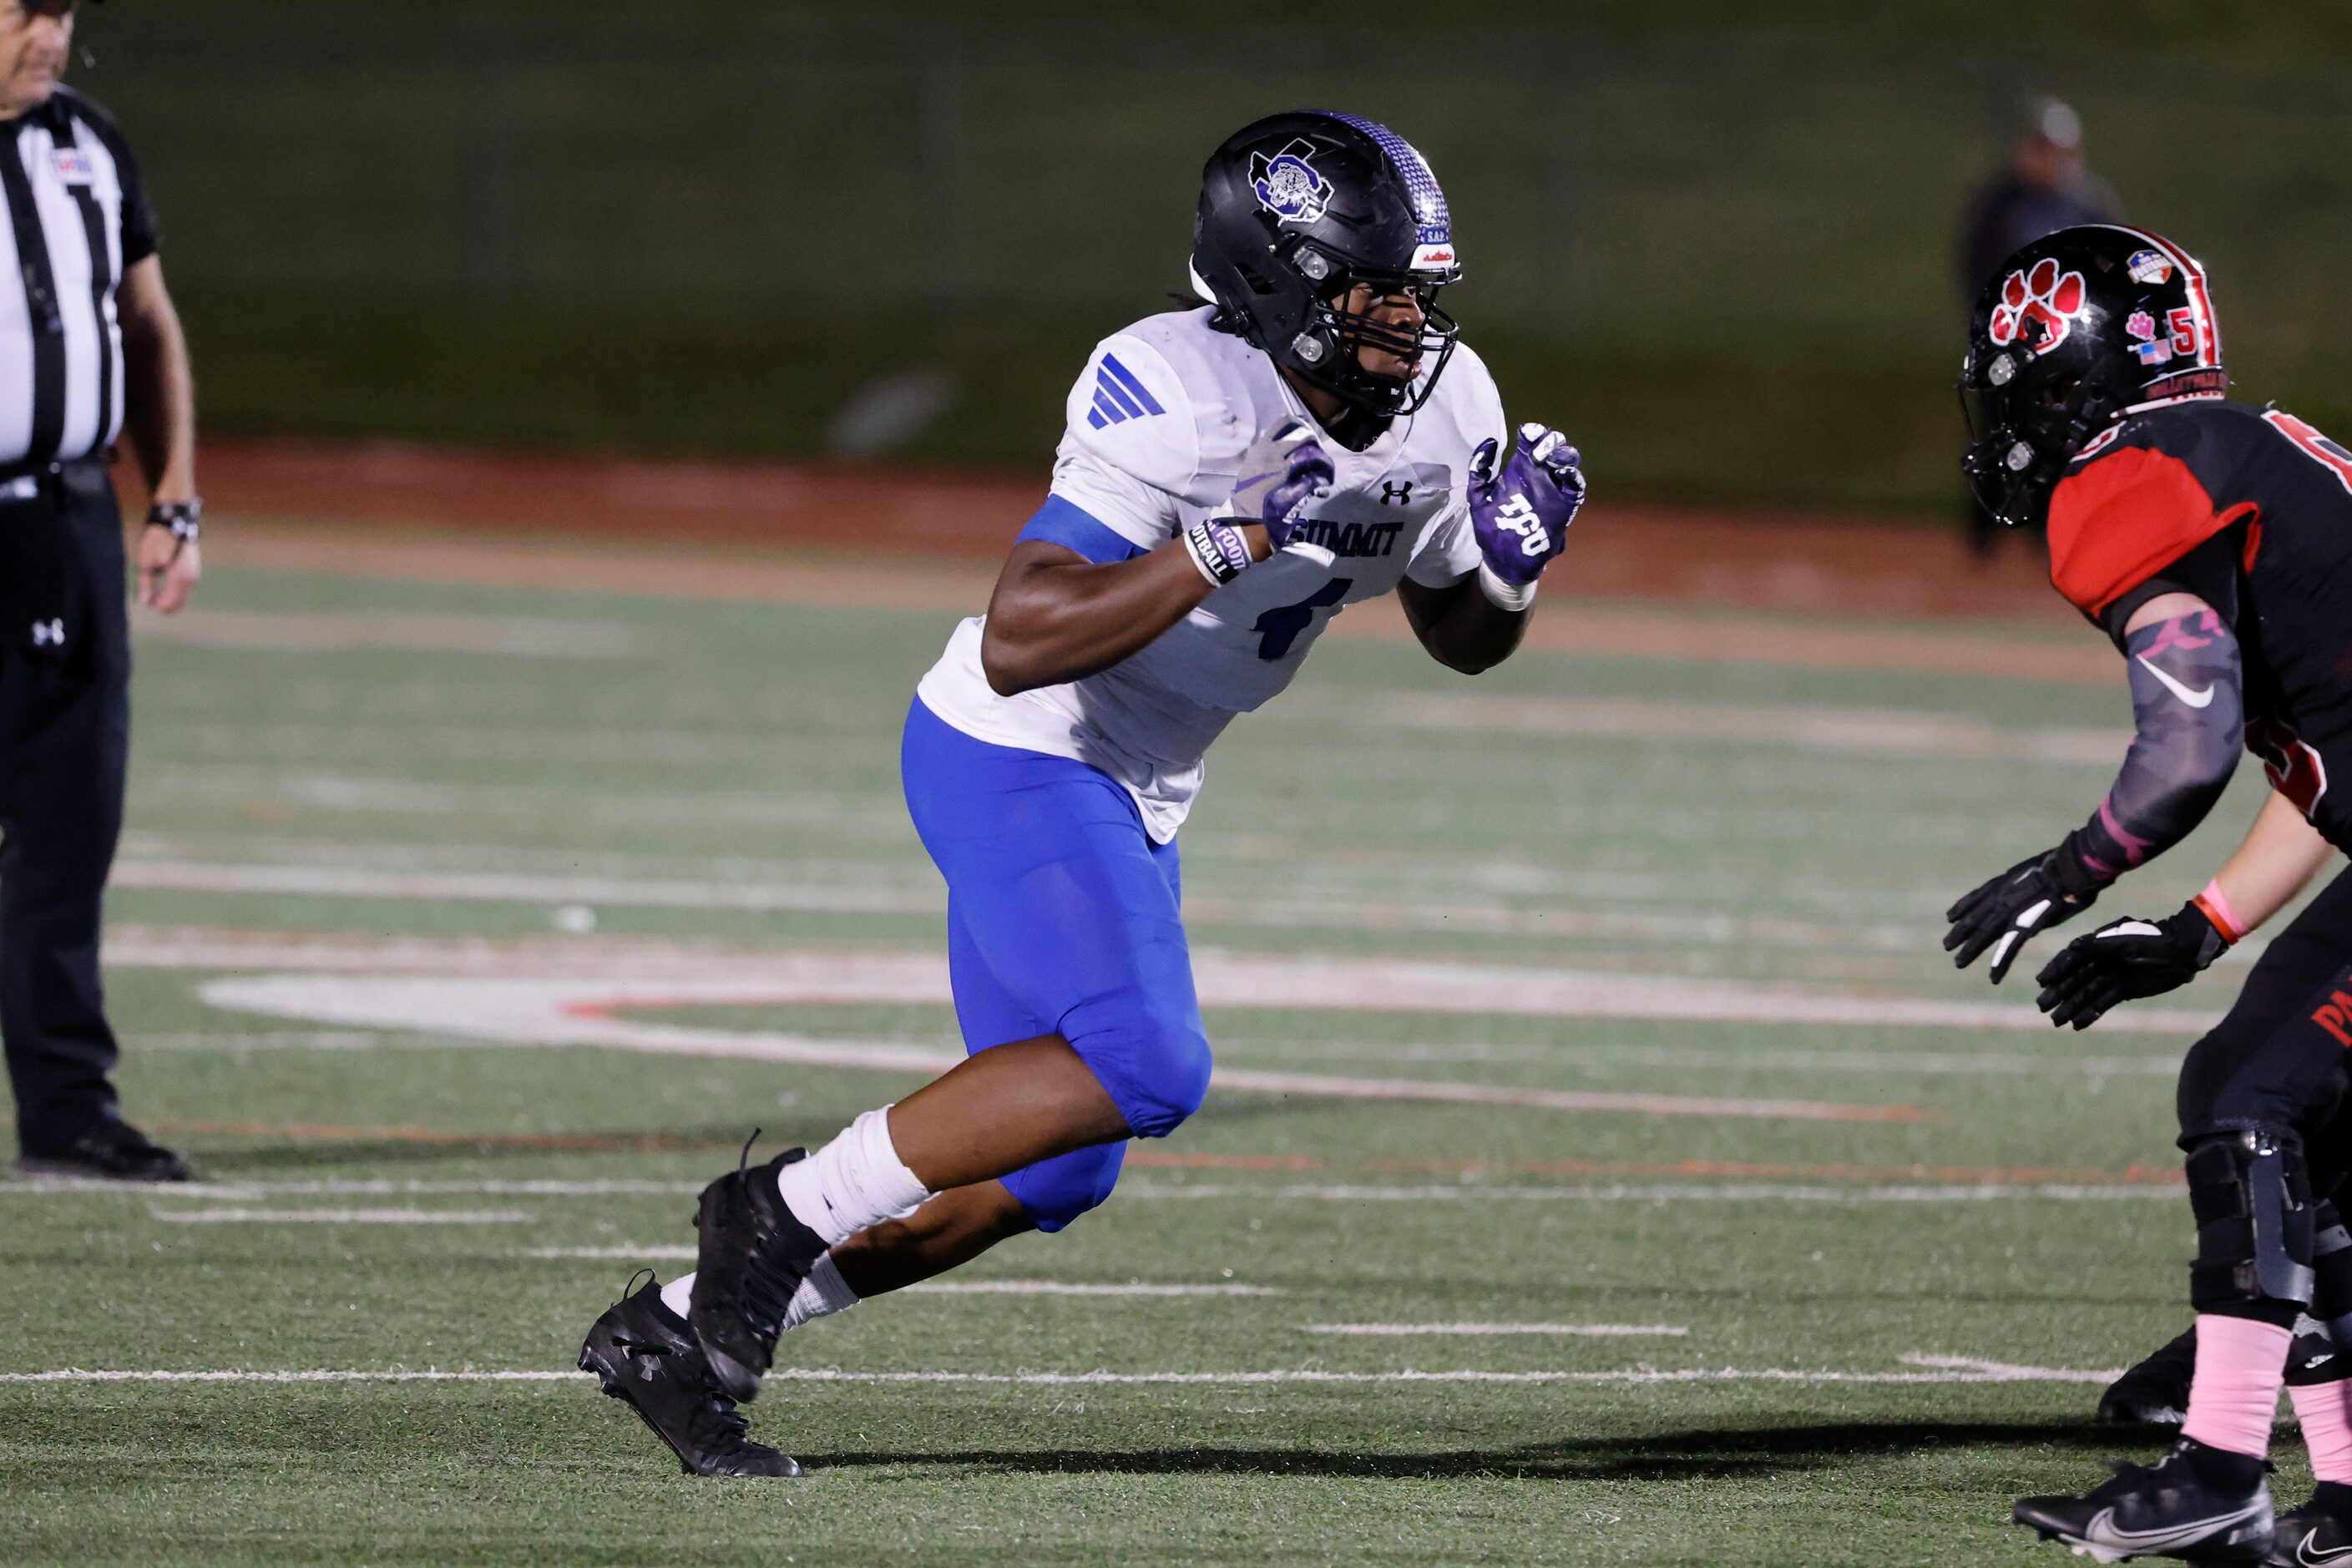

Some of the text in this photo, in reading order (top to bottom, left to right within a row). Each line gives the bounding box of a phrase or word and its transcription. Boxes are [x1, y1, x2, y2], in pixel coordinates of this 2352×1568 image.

[2167, 306, 2198, 356] 5
[1191, 522, 1228, 578] OTBALL
[1285, 518, 1404, 557] SUMMIT
[1495, 493, 1550, 557] TCU
